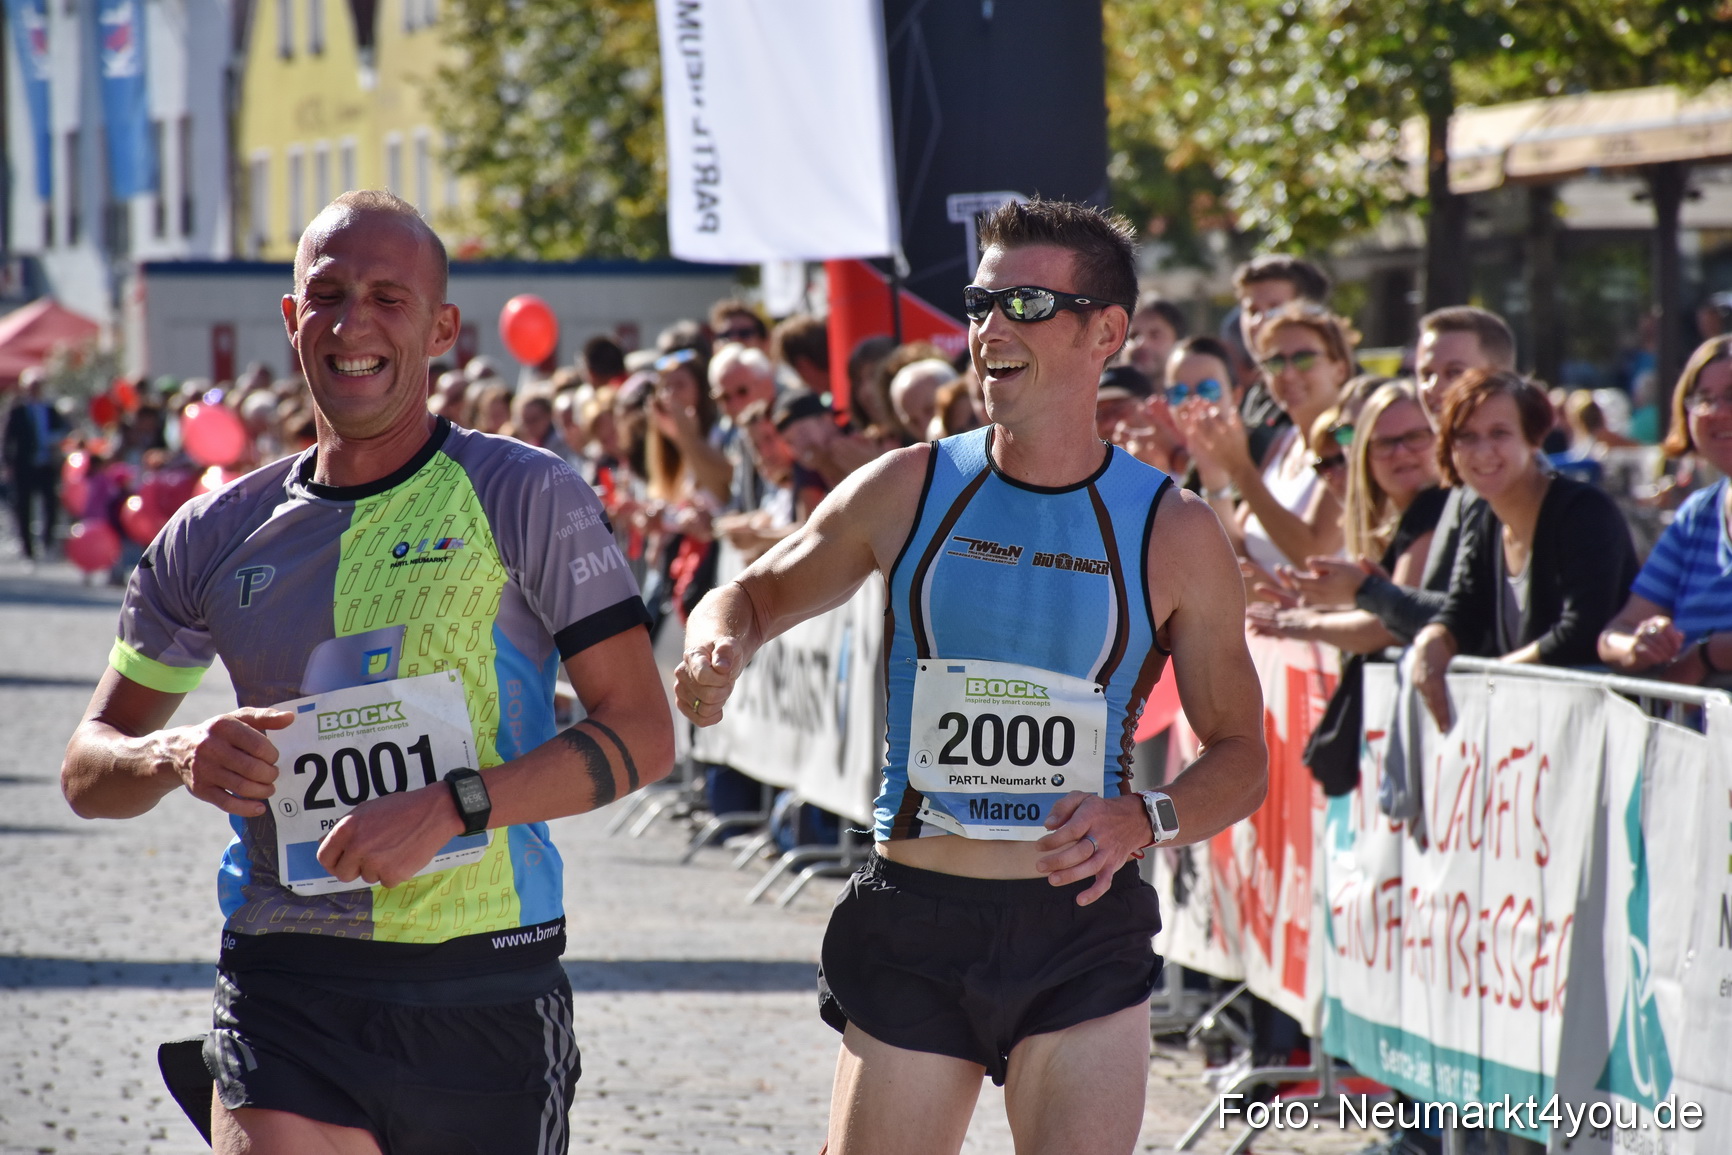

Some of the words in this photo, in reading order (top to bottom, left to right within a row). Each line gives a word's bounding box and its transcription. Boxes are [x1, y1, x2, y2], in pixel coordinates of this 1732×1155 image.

[566, 507, 586, 523] THE
[555, 524, 574, 541] 100
[390, 560, 409, 568] PARTL
[410, 556, 448, 565] NEUMARKT
[965, 677, 1050, 699] BOCK
[965, 697, 991, 705] inspired
[317, 700, 407, 733] BOCK
[318, 732, 344, 741] inspired
[356, 727, 376, 735] smart
[377, 721, 409, 732] concepts
[938, 711, 1075, 767] 2000
[294, 734, 438, 811] 2001
[949, 775, 987, 786] PARTL
[990, 775, 1046, 786] Neumarkt
[969, 798, 1040, 821] Marco
